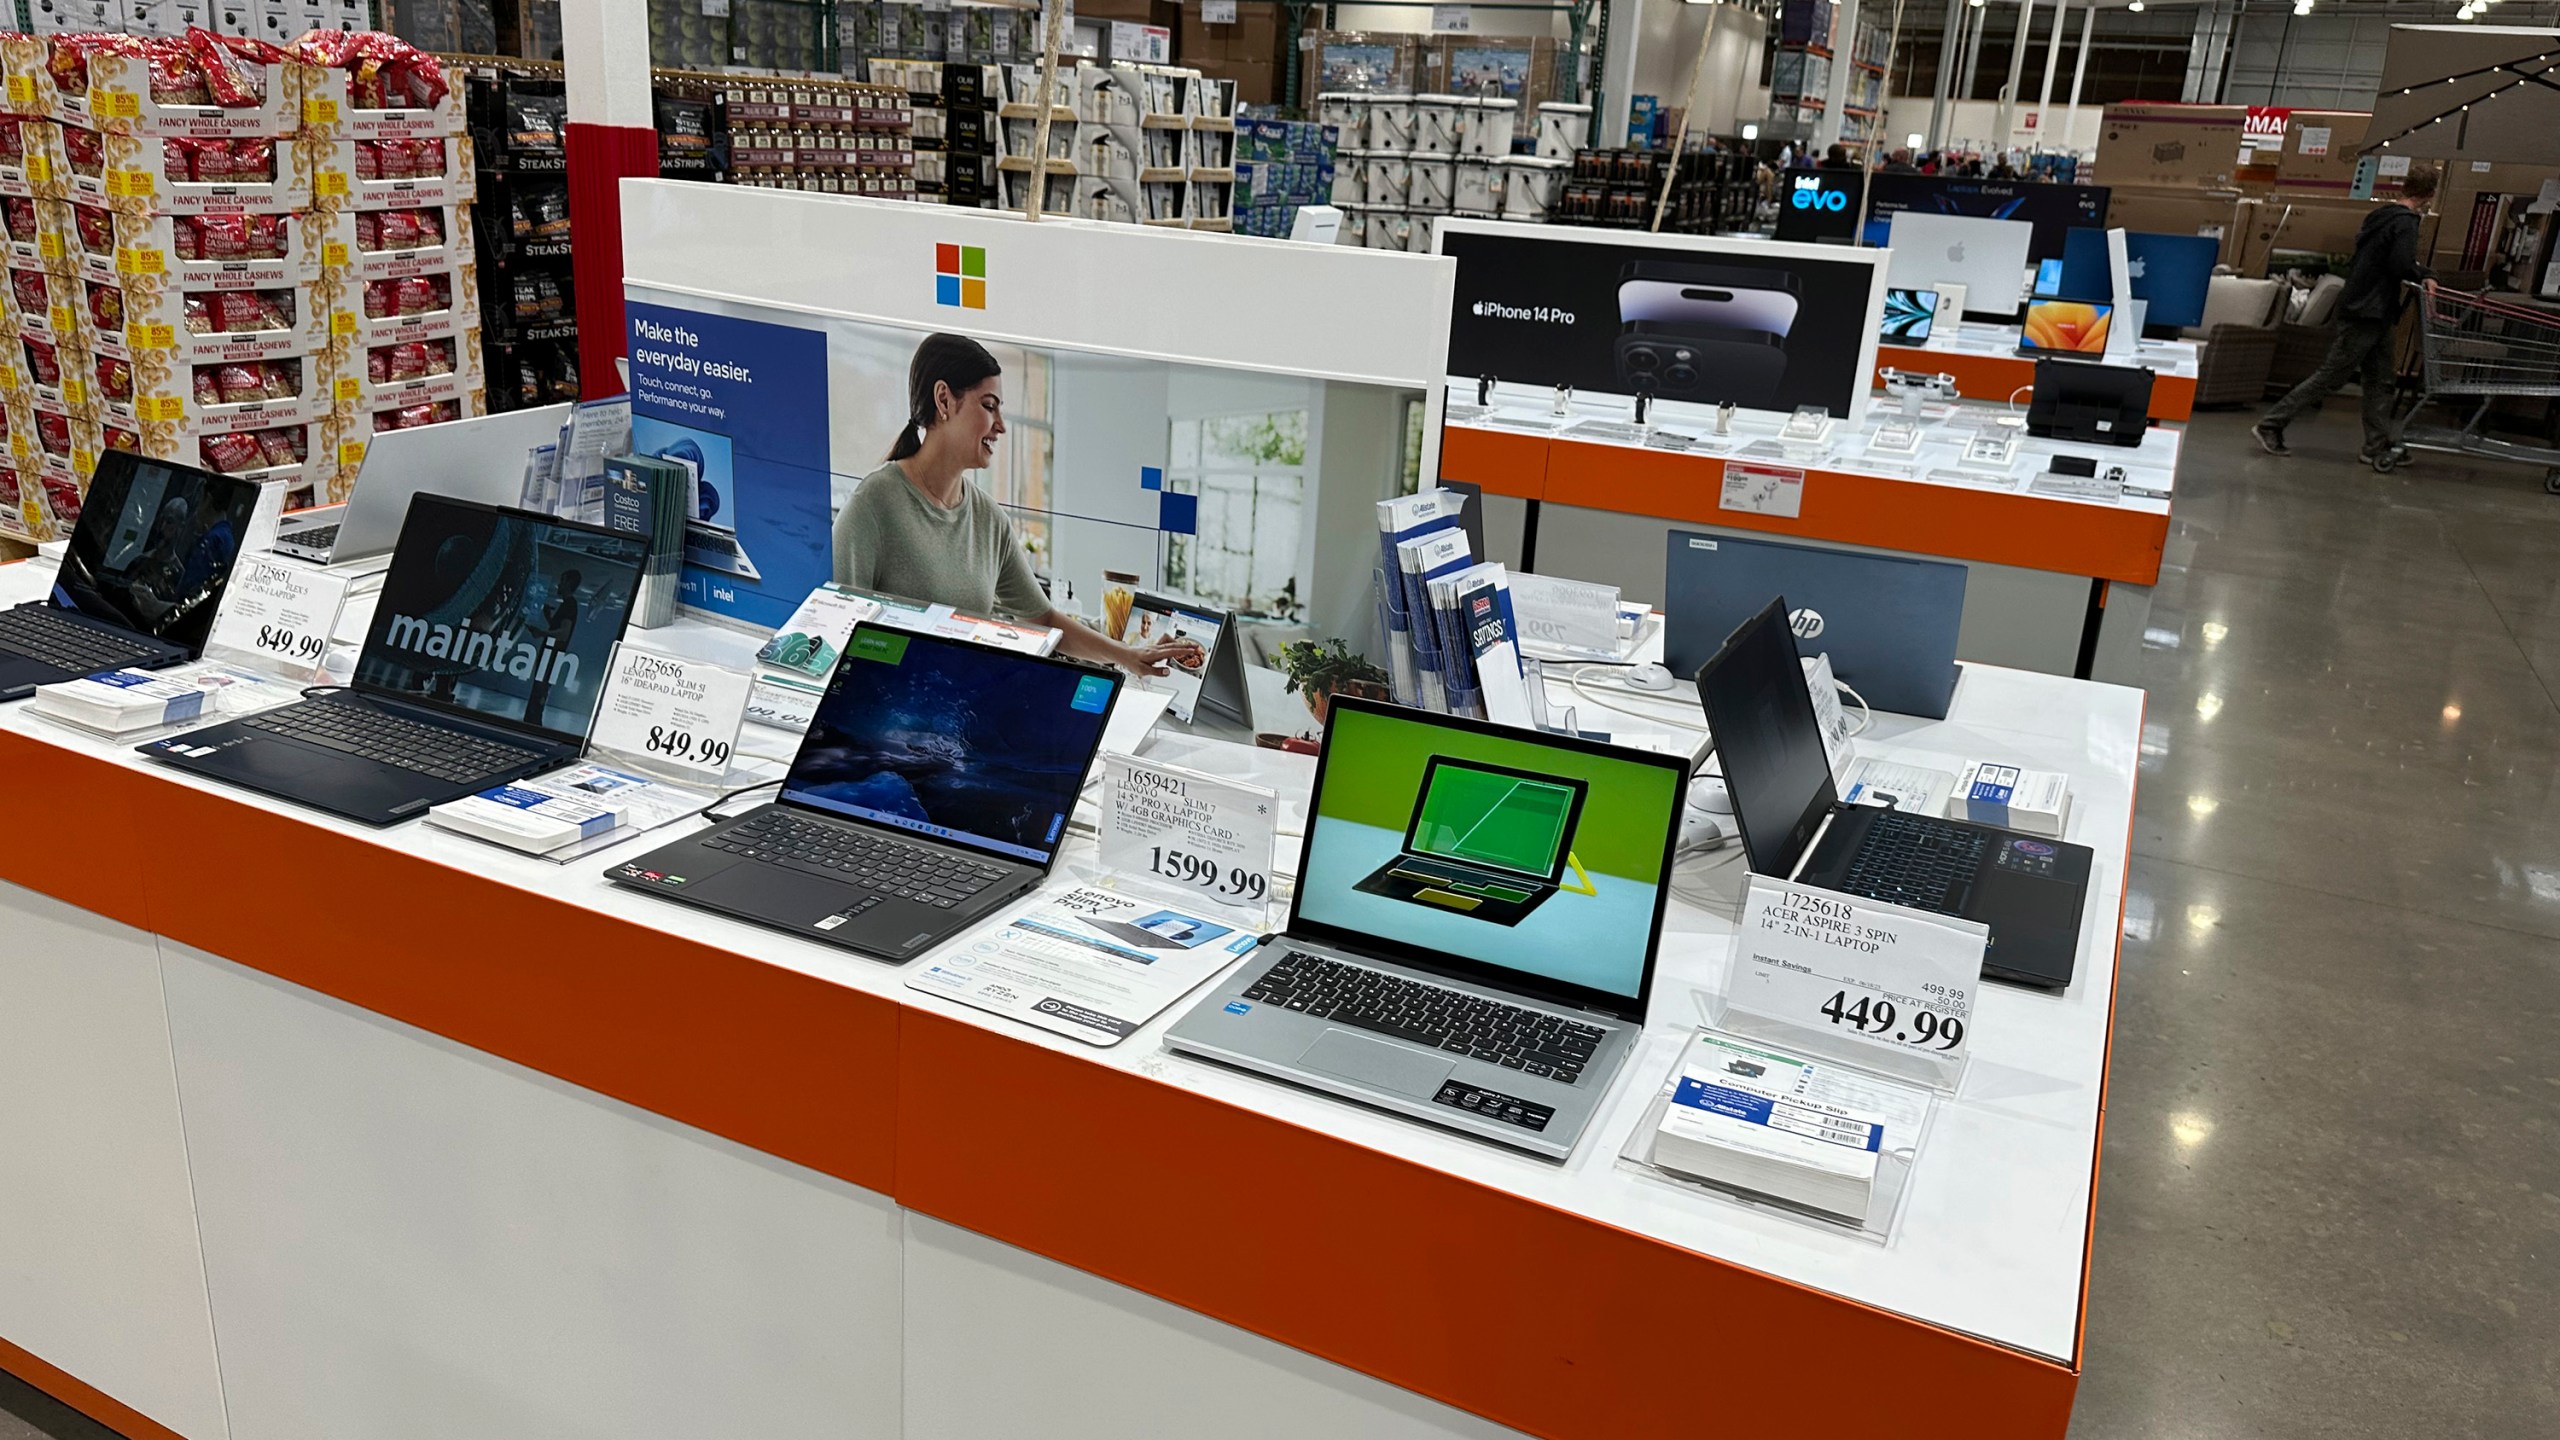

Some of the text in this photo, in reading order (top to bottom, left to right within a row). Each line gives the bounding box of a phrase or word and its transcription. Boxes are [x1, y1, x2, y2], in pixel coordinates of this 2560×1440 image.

[158, 118, 261, 129] FANCY WHOLE CASHEWS
[352, 120, 435, 130] FANCY WHOLE CASHEWS
[519, 158, 553, 170] STEAK
[674, 158, 705, 168] STRIPS
[173, 195, 273, 205] FANCY WHOLE CASHEWS
[362, 189, 444, 201] FANCY WHOLE CASHEWS
[1791, 189, 1847, 212] evo
[1981, 186, 2013, 197] Evolved
[205, 230, 235, 240] WHOLE
[525, 243, 560, 256] STEAK
[363, 256, 444, 272] FANCY WHOLE CASHEWS
[183, 270, 284, 282] FANCY WHOLE CASHEWS
[222, 299, 249, 309] WHOLE
[1484, 301, 1575, 325] iPhone 14 Pro
[371, 320, 450, 338] FANCY WHOLE CASHEWS
[634, 318, 699, 348] Make the
[193, 340, 292, 355] FANCY WHOLE CASHEWS
[636, 348, 753, 383] everyday easier.
[375, 383, 454, 404] FANCY WHOLE CASHEWS
[637, 372, 714, 400] Touch, connect, go.
[582, 407, 623, 420] Here to help
[638, 388, 727, 420] Performance your way.
[201, 408, 298, 425] FANCY WHOLE CASHEWS
[613, 492, 640, 509] Costco
[613, 514, 640, 533] FREE
[245, 573, 309, 595] LENOVO FLEX 5
[254, 563, 292, 584] 1725651
[269, 588, 296, 601] LAPTOP
[1473, 619, 1504, 648] SAVINGS
[1791, 608, 1821, 639] hp
[256, 624, 324, 661] 849.99
[386, 613, 580, 693] maintain
[632, 655, 684, 679] 1725656
[622, 666, 657, 681] LENOVO
[676, 678, 698, 691] SLIM
[633, 678, 670, 694] IDEAPAD
[671, 687, 704, 702] LAPTOP
[646, 725, 730, 767] 849.99
[1126, 767, 1187, 797] 1659421
[1117, 779, 1217, 814] LENOVO SLIM 7
[1115, 800, 1233, 840] W/ 4GB GRAPHICS CARD
[1141, 796, 1161, 810] PRO
[1163, 802, 1171, 812] X
[1173, 804, 1213, 824] LAPTOP
[1149, 846, 1266, 901] 1599.99
[1052, 898, 1104, 916] Pro X
[1064, 892, 1119, 912] Slim 7
[1073, 886, 1136, 909] Lenovo
[1781, 891, 1853, 920] 1725618
[1761, 905, 1898, 945] ACER ASPIRE 3 SPIN
[1230, 936, 1256, 953] Lenovo
[1760, 917, 1881, 955] 14" 2-IN-1 LAPTOP
[1752, 953, 1813, 974] Instant Savings
[1921, 982, 1965, 1000] 499.99
[1064, 1004, 1084, 1013] Please
[1882, 992, 1968, 1020] PRICE AT REGISTER
[1820, 989, 1964, 1051] 449.99
[1478, 1089, 1495, 1097] Aspire
[1718, 1078, 1778, 1100] Computer
[1780, 1094, 1824, 1110] Pickup
[1825, 1104, 1849, 1116] Slip
